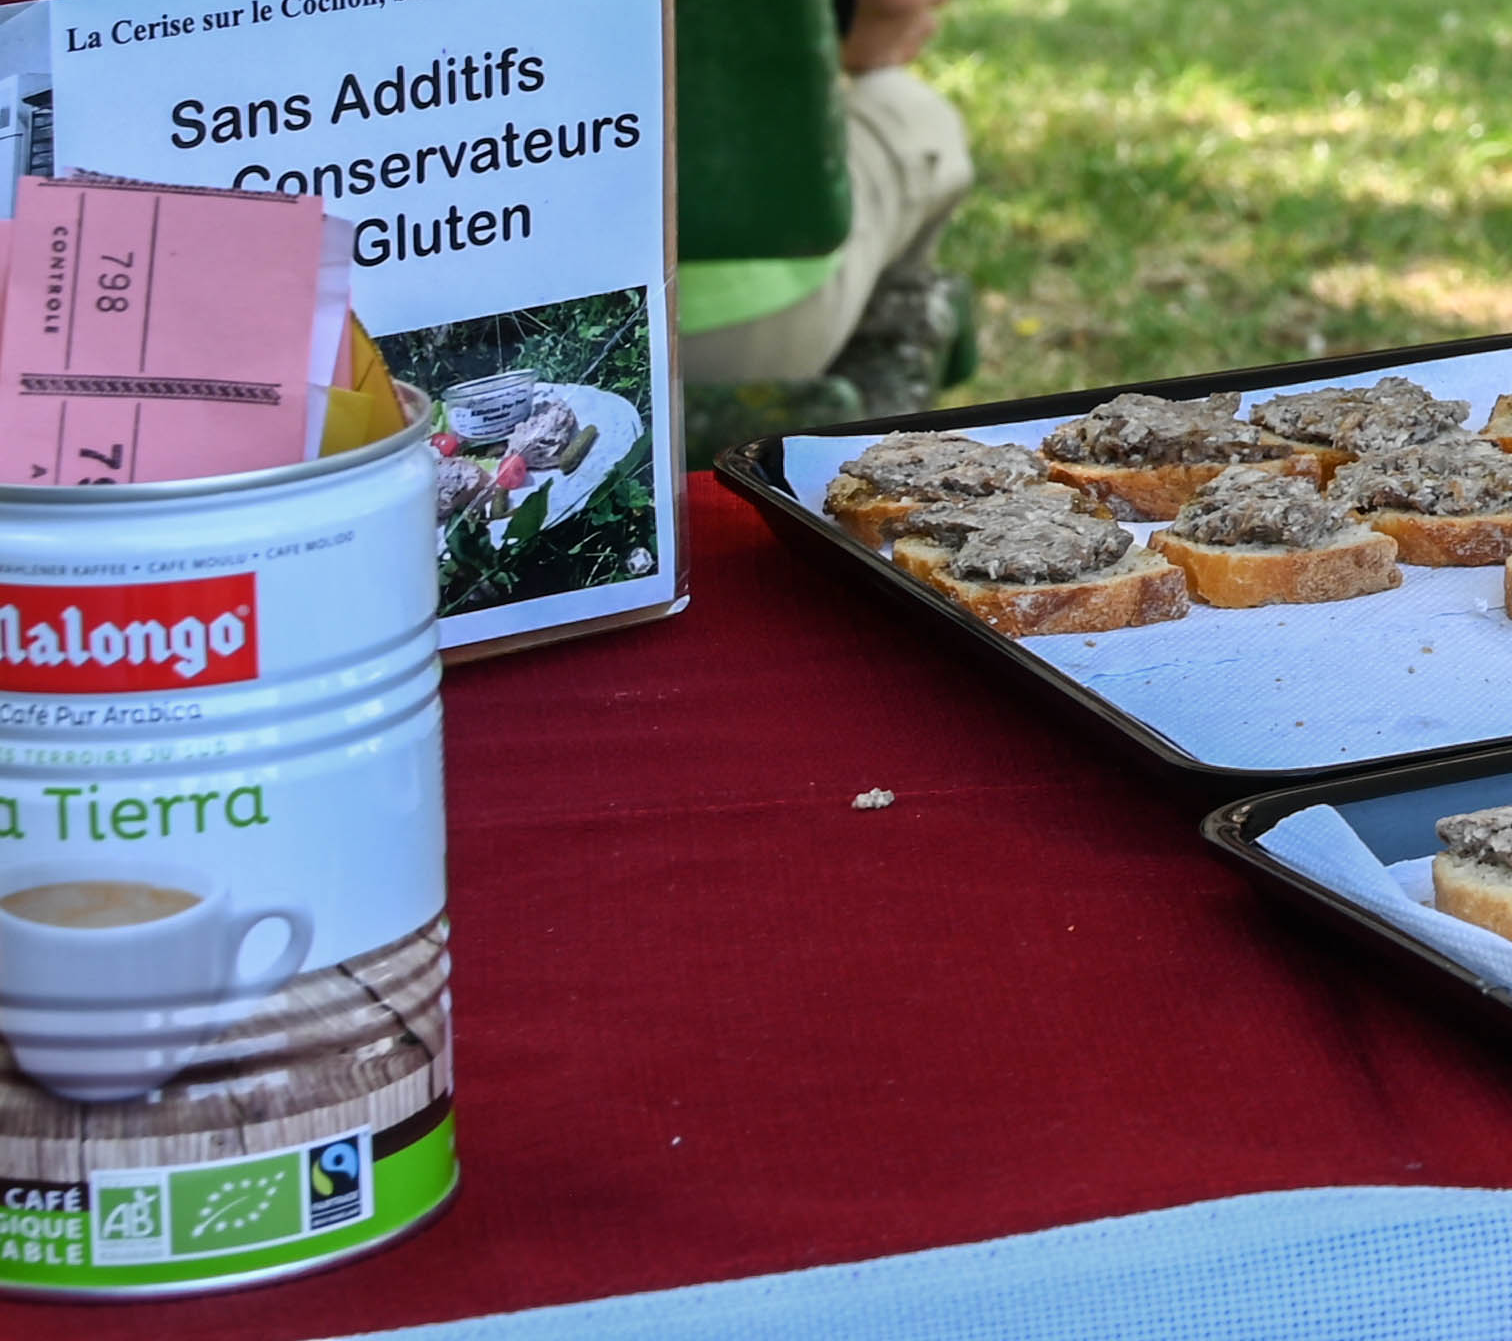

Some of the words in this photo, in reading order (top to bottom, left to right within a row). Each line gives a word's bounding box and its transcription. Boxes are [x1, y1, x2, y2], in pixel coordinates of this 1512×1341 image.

[67, 27, 102, 53] La
[111, 13, 196, 47] Cerise
[203, 10, 244, 31] sur
[251, 0, 273, 24] le
[170, 87, 311, 151] Sans
[330, 46, 546, 125] Additifs
[351, 201, 532, 269] Gluten
[95, 251, 134, 313] 798
[54, 706, 97, 727] Pur
[103, 701, 203, 725] Arabica
[43, 783, 270, 841] Tierra
[4, 1186, 82, 1213] CAFÉ
